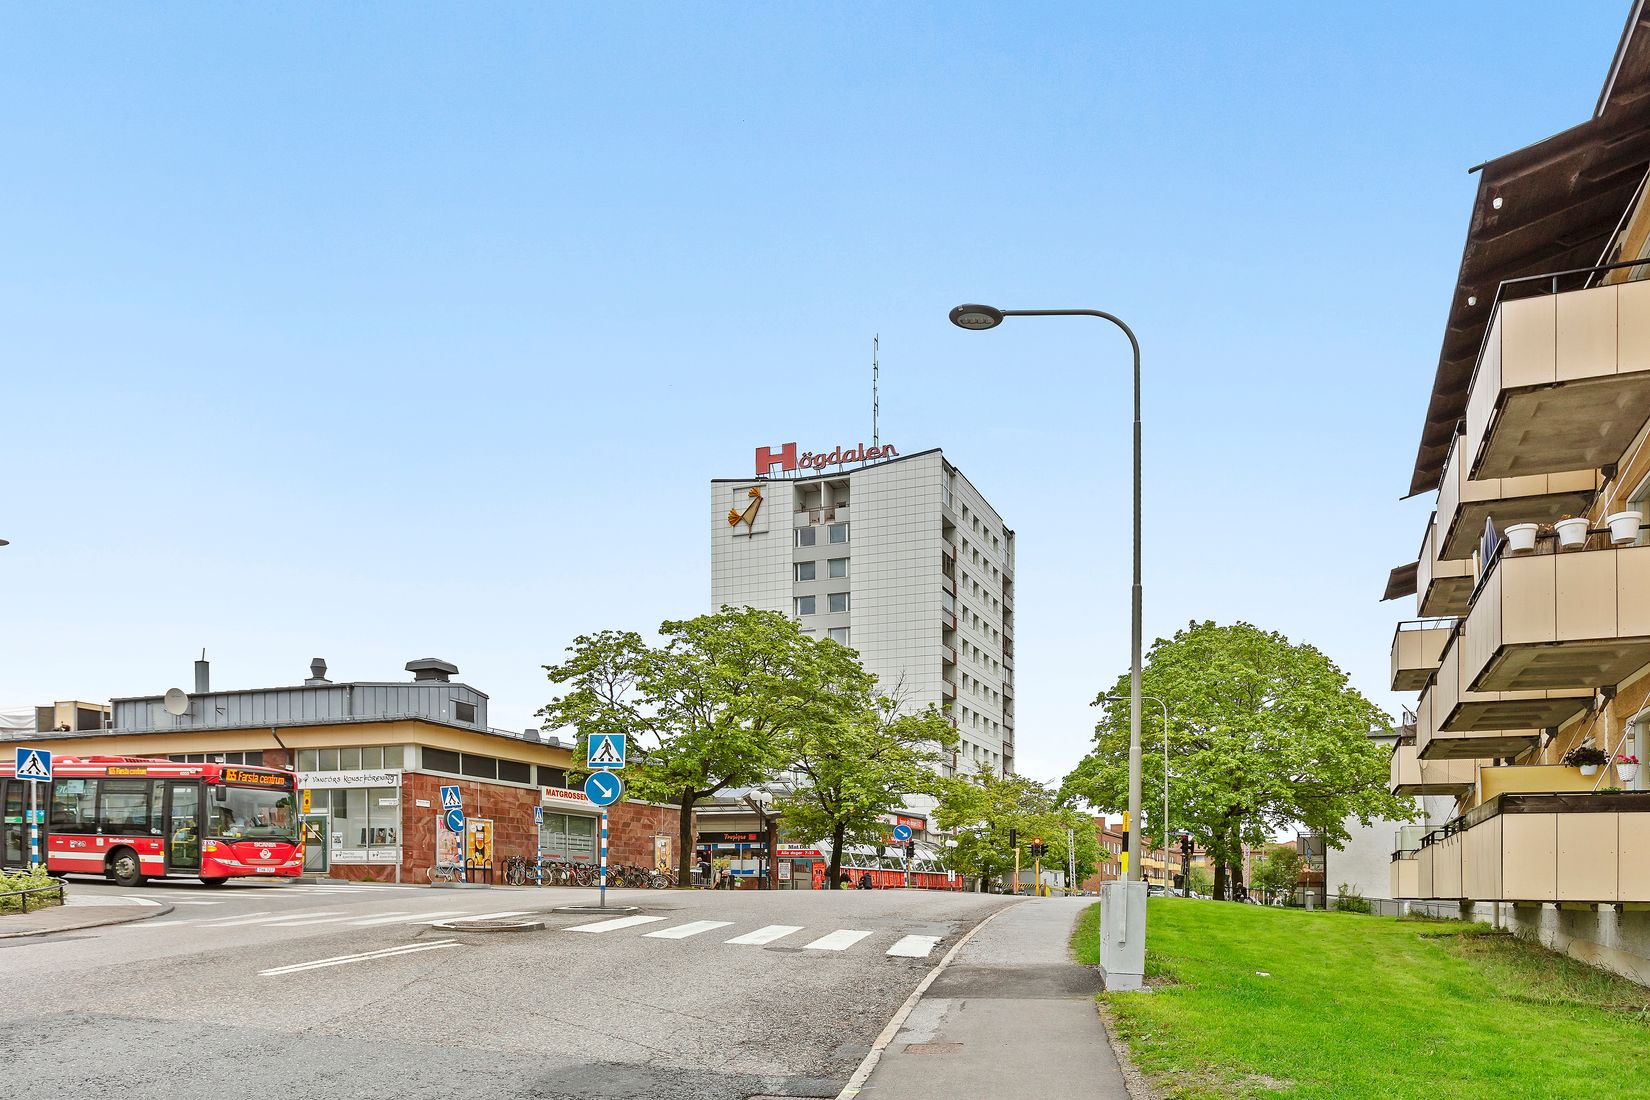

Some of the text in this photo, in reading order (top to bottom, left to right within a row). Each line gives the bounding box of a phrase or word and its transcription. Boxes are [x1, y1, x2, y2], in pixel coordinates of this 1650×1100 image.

[756, 442, 899, 475] Högdalen
[238, 772, 258, 784] Farsta
[260, 774, 284, 785] centrum
[546, 788, 588, 801] MATGROSSEN
